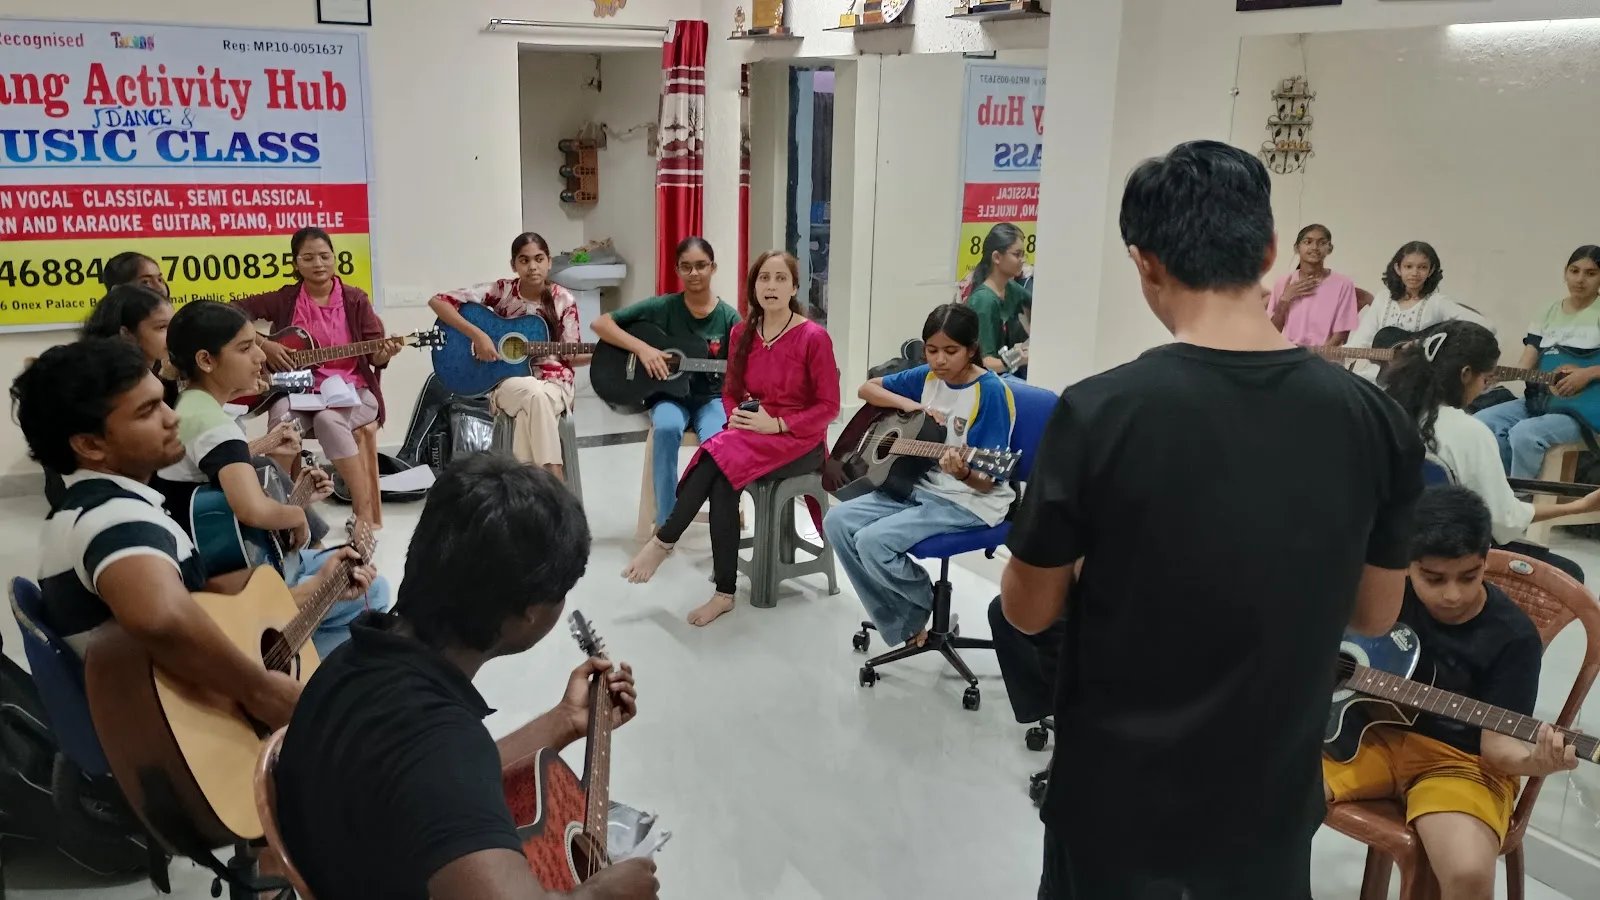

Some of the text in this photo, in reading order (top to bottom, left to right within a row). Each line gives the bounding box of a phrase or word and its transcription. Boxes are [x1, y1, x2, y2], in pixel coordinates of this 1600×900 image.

[0, 31, 84, 50] ecognised
[223, 39, 250, 53] Reg:
[83, 62, 251, 121] Activity
[264, 68, 347, 112] Hub
[0, 128, 320, 164] USIC CLASS
[16, 190, 74, 209] VOCAL
[82, 189, 174, 208] CLASSICAL
[187, 190, 228, 207] SEMI
[232, 189, 315, 206] CLASSICAL
[22, 215, 57, 234] AND
[62, 214, 144, 233] KARAOKE
[152, 213, 216, 233] GUITAR,
[220, 213, 272, 232] PIANO,
[276, 212, 344, 230] UKULELE
[46, 298, 85, 309] Palace
